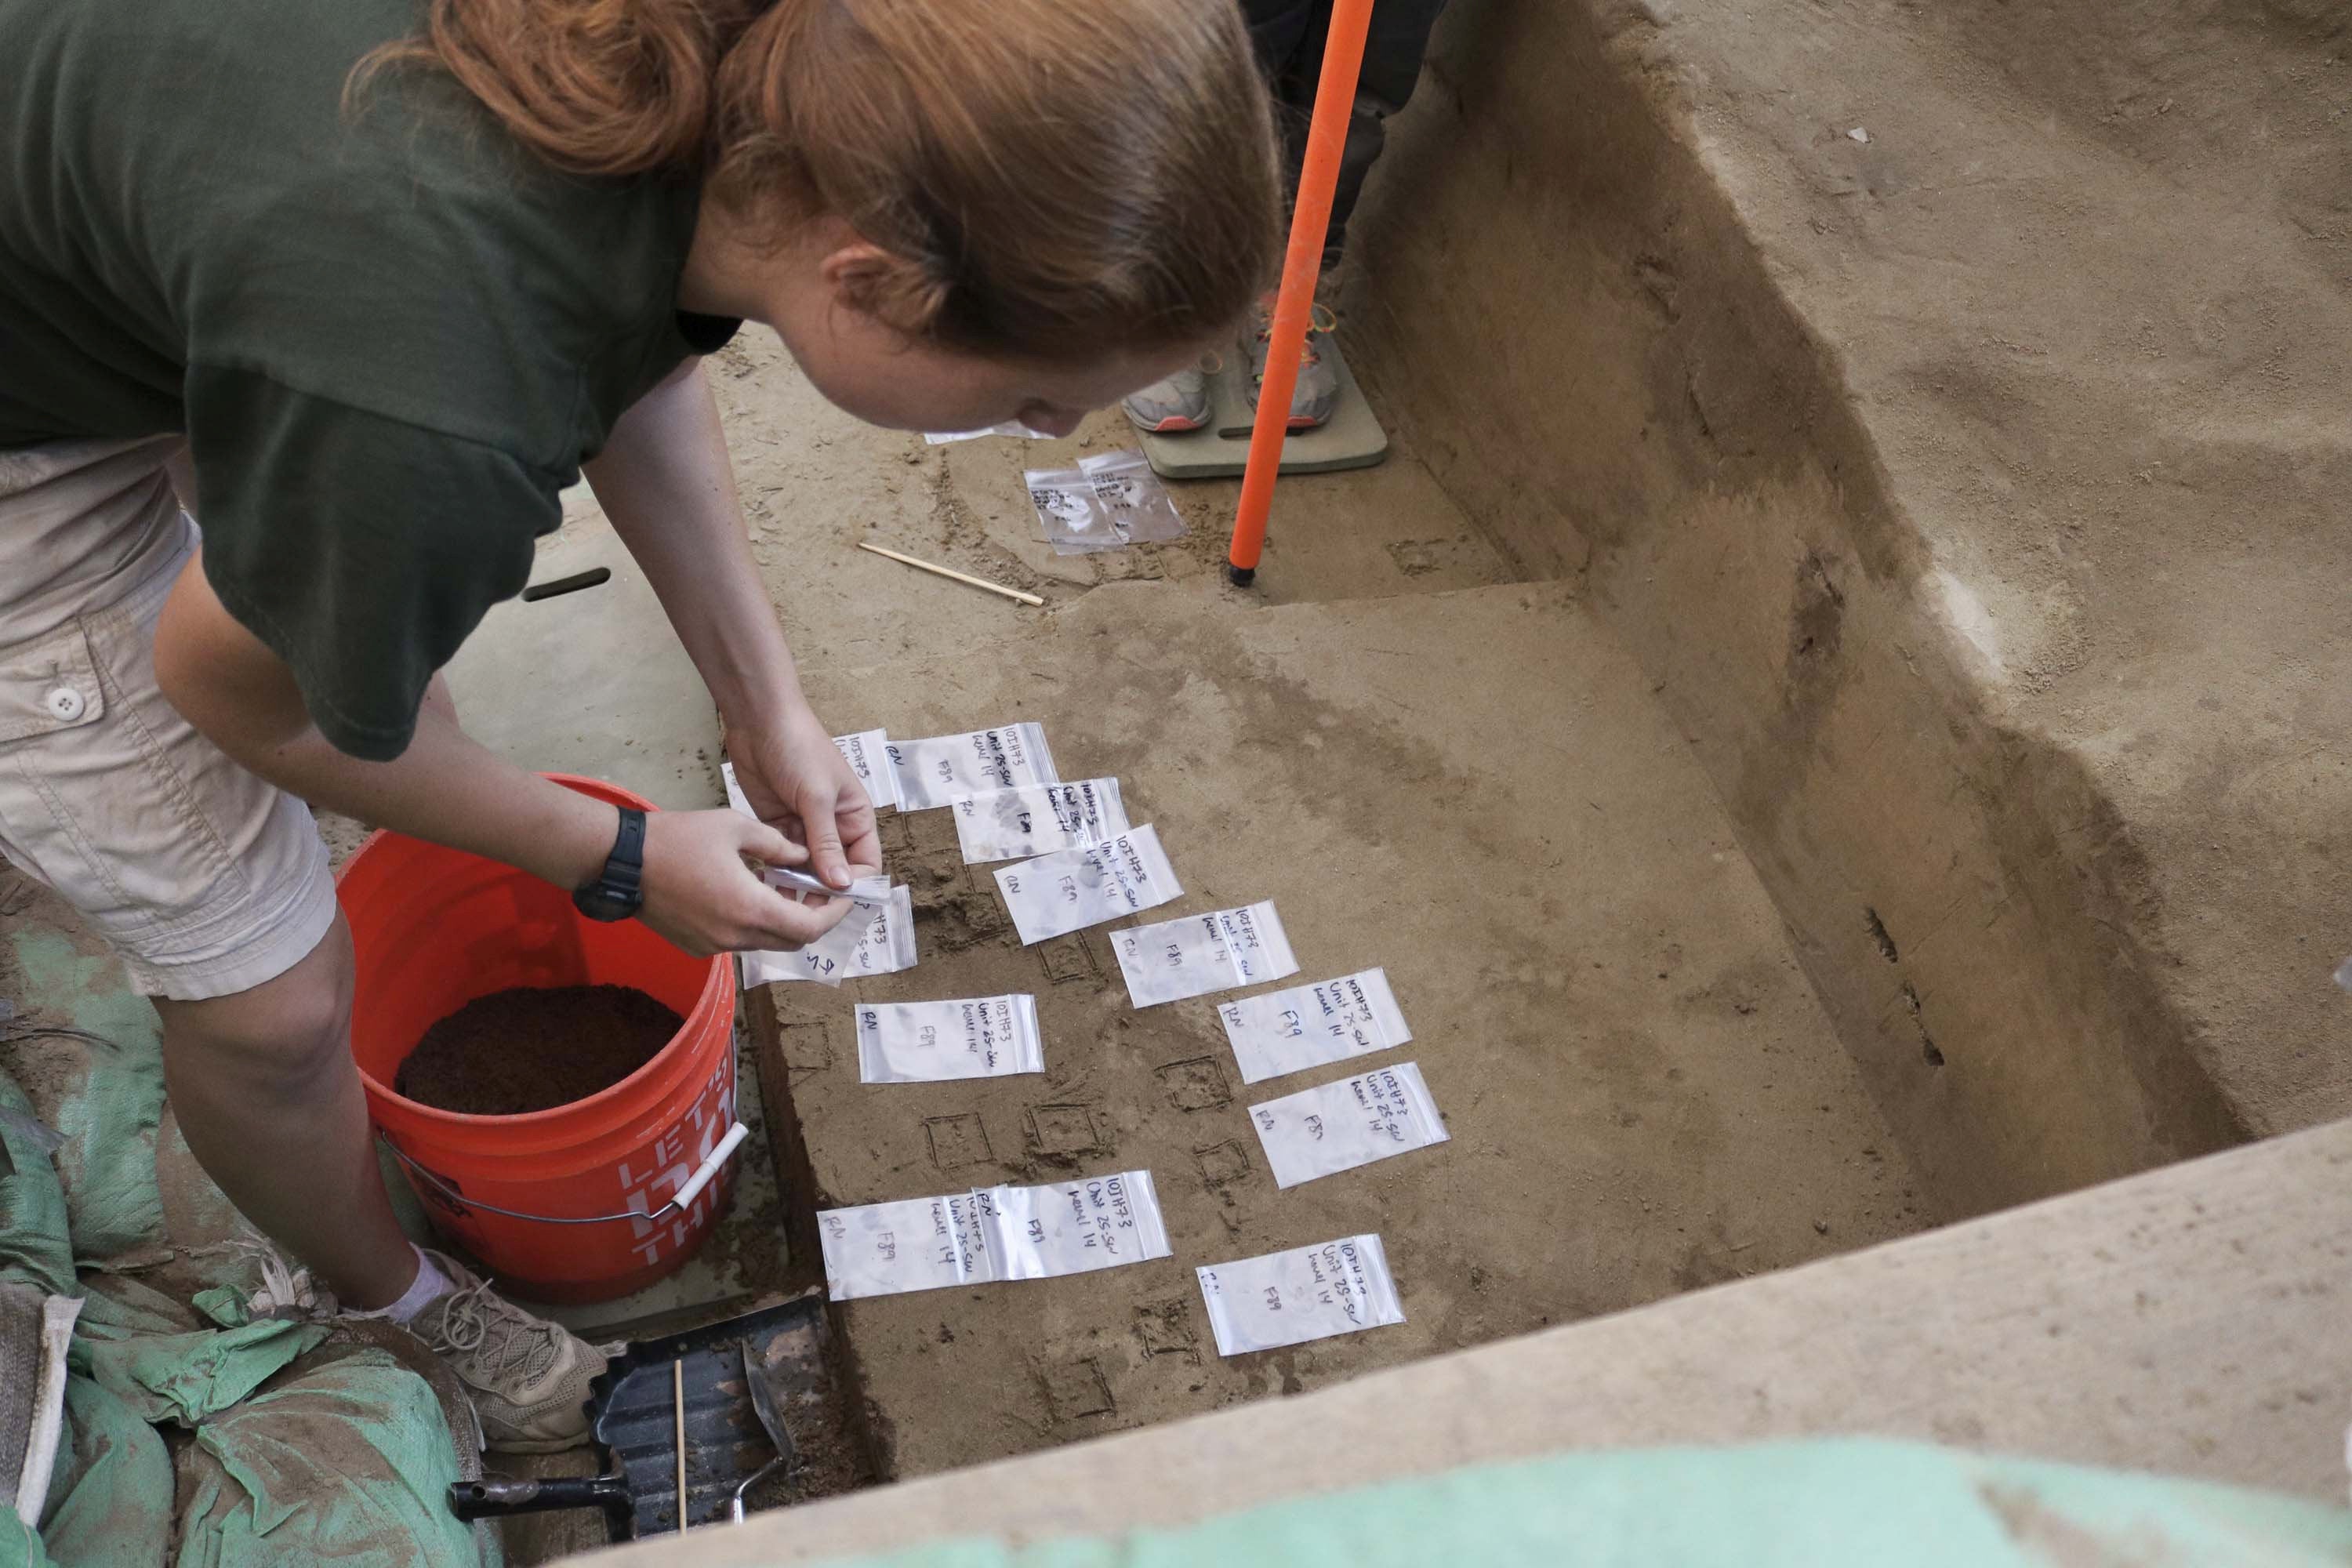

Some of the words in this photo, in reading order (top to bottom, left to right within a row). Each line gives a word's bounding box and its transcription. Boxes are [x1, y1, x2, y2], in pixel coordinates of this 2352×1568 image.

[987, 731, 1003, 751] Unit
[885, 746, 905, 765] RN
[938, 759, 953, 783] F89
[981, 764, 994, 776] 14
[959, 800, 975, 816] RN
[1099, 841, 1119, 863] Unit
[1004, 876, 1021, 894] RN
[1060, 876, 1077, 901] F89
[1104, 882, 1118, 897] 14
[873, 913, 887, 945] H73
[1167, 944, 1182, 967] F89
[1215, 949, 1228, 962] 14
[1330, 982, 1348, 1008] Unit
[861, 1011, 877, 1029] RN
[978, 1003, 989, 1027] Unit
[1223, 1007, 1244, 1028] RN
[1279, 1010, 1303, 1039] F89
[917, 1025, 937, 1047] F89
[1328, 1025, 1345, 1036] 14
[966, 1038, 978, 1054] 14
[1367, 1074, 1385, 1100] Unit
[1255, 1109, 1275, 1131] RN
[1305, 1115, 1323, 1141] F89
[1369, 1120, 1384, 1131] 14
[977, 1192, 993, 1216] RN
[1086, 1181, 1105, 1208] Unit
[949, 1199, 966, 1226] Unit
[825, 1216, 847, 1239] RN
[1028, 1218, 1046, 1243] F89
[877, 1231, 896, 1261] F89
[1083, 1232, 1097, 1248] 14
[938, 1245, 956, 1264] 14
[1323, 1244, 1342, 1273] Unit
[1263, 1286, 1282, 1311] F89
[1318, 1290, 1334, 1305] 14
